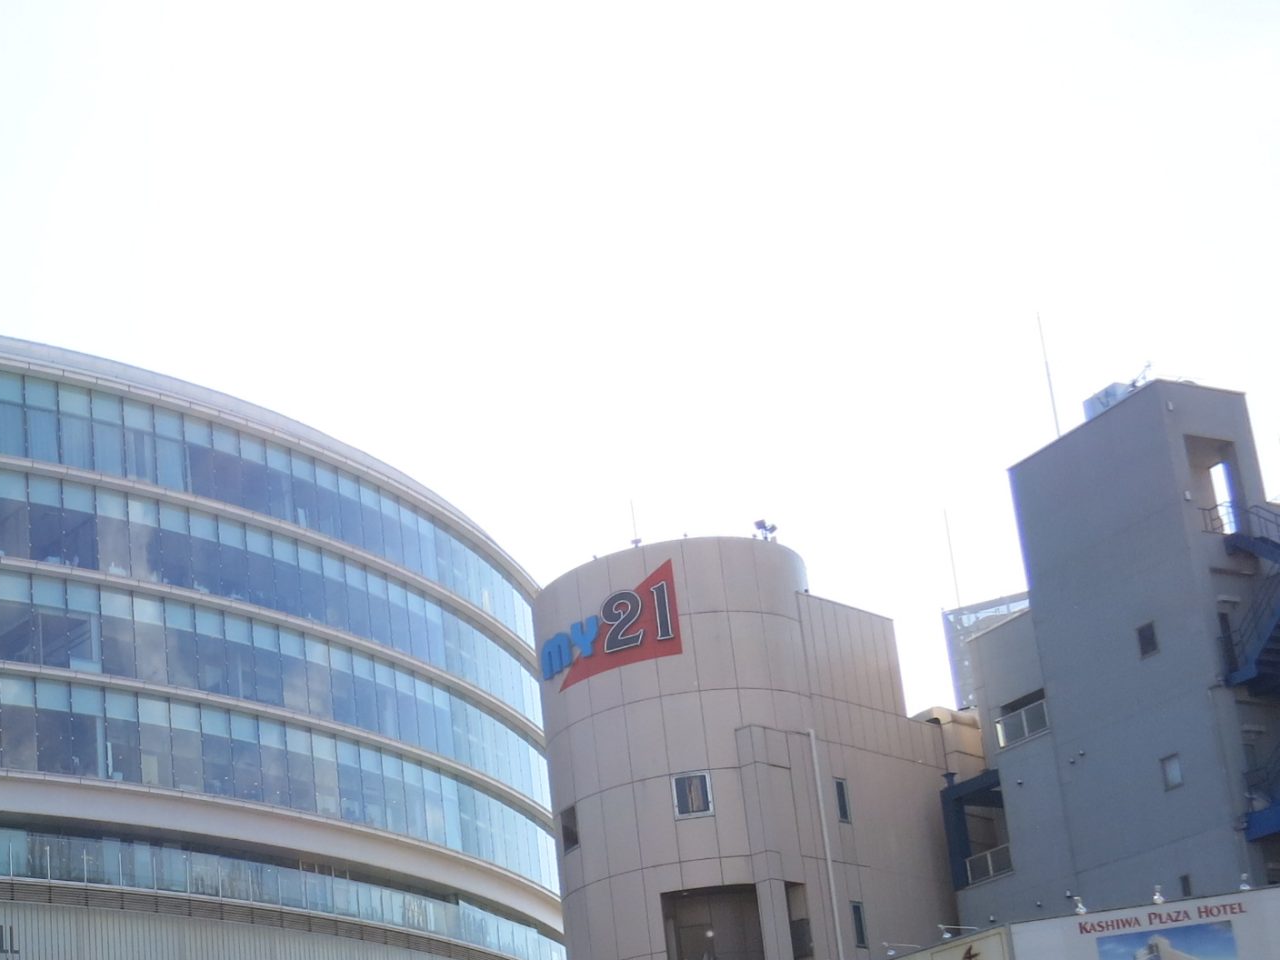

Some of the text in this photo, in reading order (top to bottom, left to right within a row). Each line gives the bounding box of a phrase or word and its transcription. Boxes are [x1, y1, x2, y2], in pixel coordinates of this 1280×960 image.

[1078, 902, 1247, 934] KASHIWA PLAZA HOTEL
